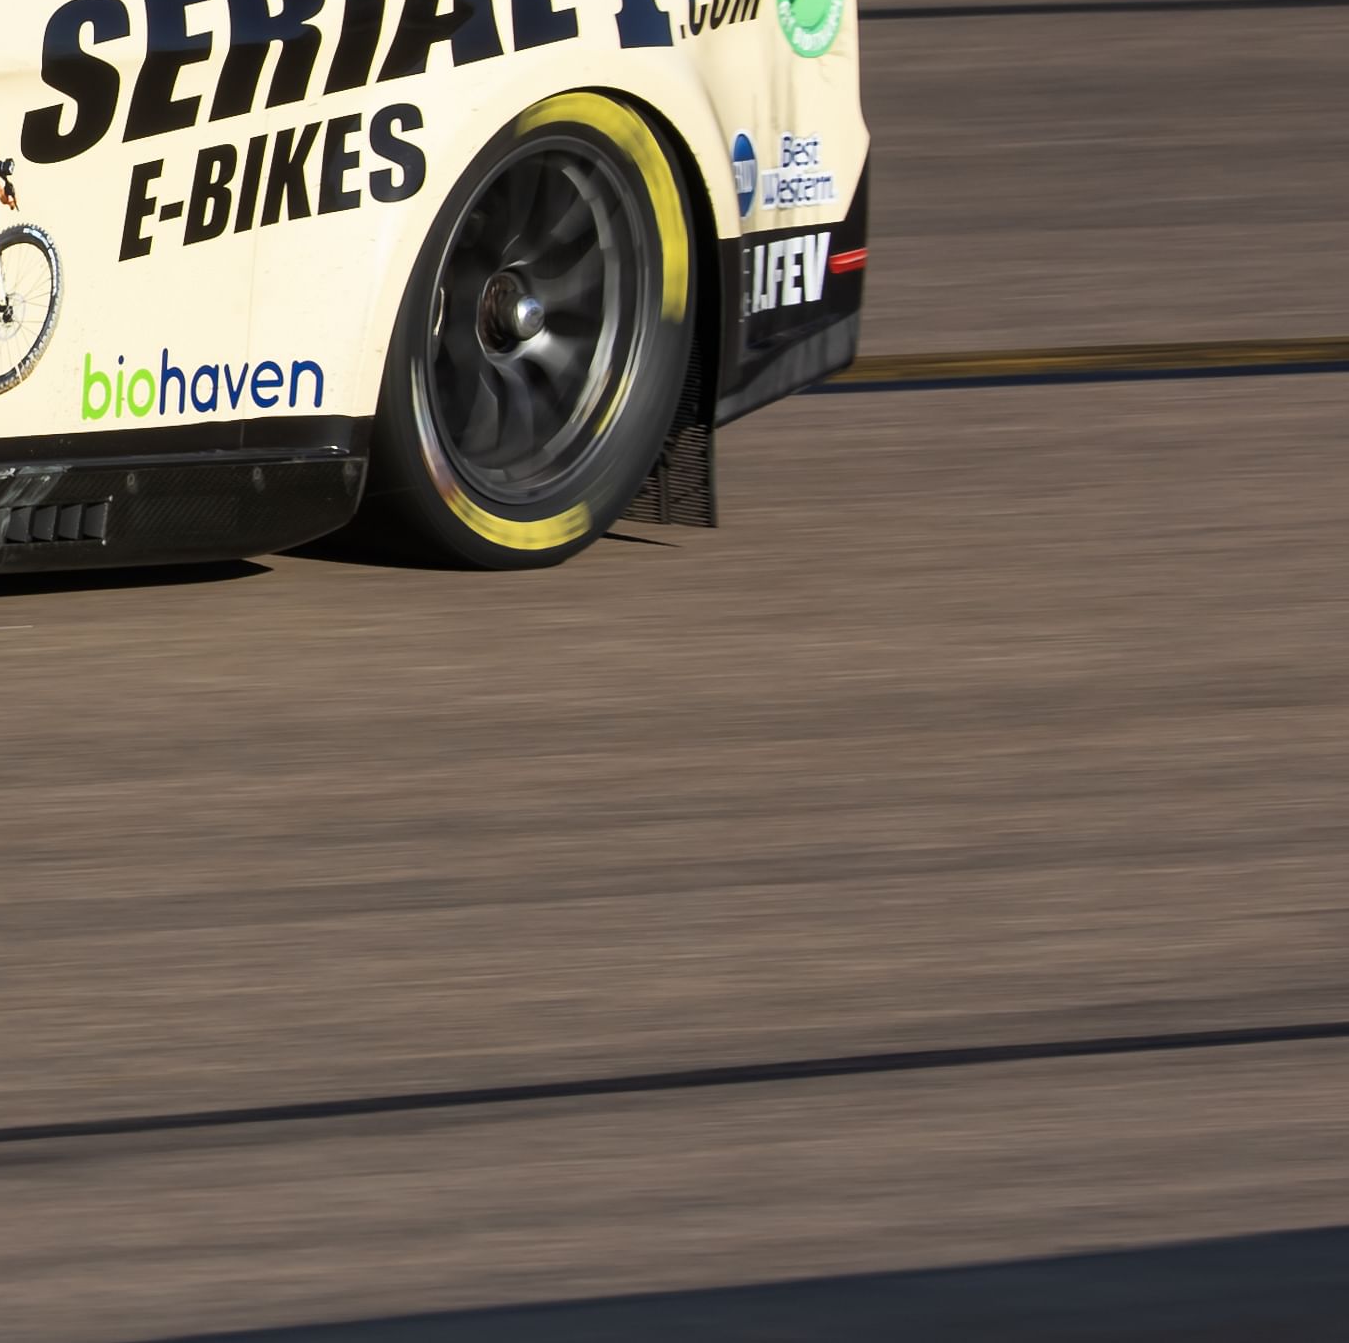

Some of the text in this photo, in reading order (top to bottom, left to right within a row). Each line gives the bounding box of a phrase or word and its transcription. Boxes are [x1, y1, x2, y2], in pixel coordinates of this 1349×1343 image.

[118, 103, 427, 262] E-BIKES
[780, 135, 820, 168] Best
[81, 348, 324, 421] biohaven
